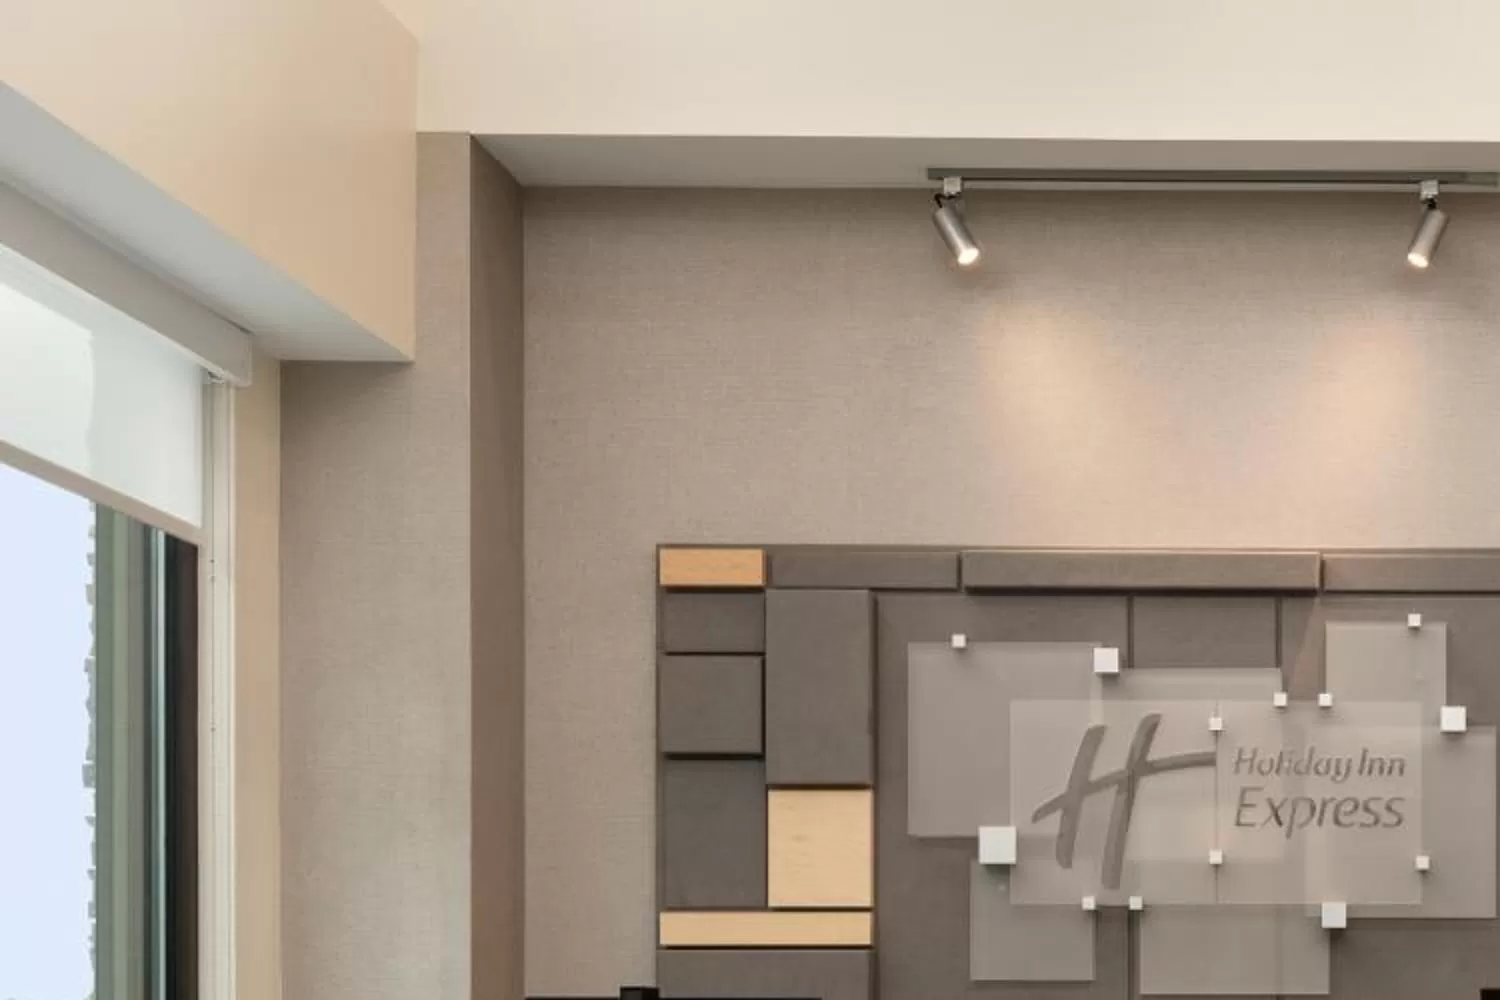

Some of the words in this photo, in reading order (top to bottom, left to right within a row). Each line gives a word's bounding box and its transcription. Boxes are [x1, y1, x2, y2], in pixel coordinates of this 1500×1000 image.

[1233, 745, 1352, 784] Holiday
[1357, 747, 1406, 777] Inn
[1234, 785, 1406, 840] Express
